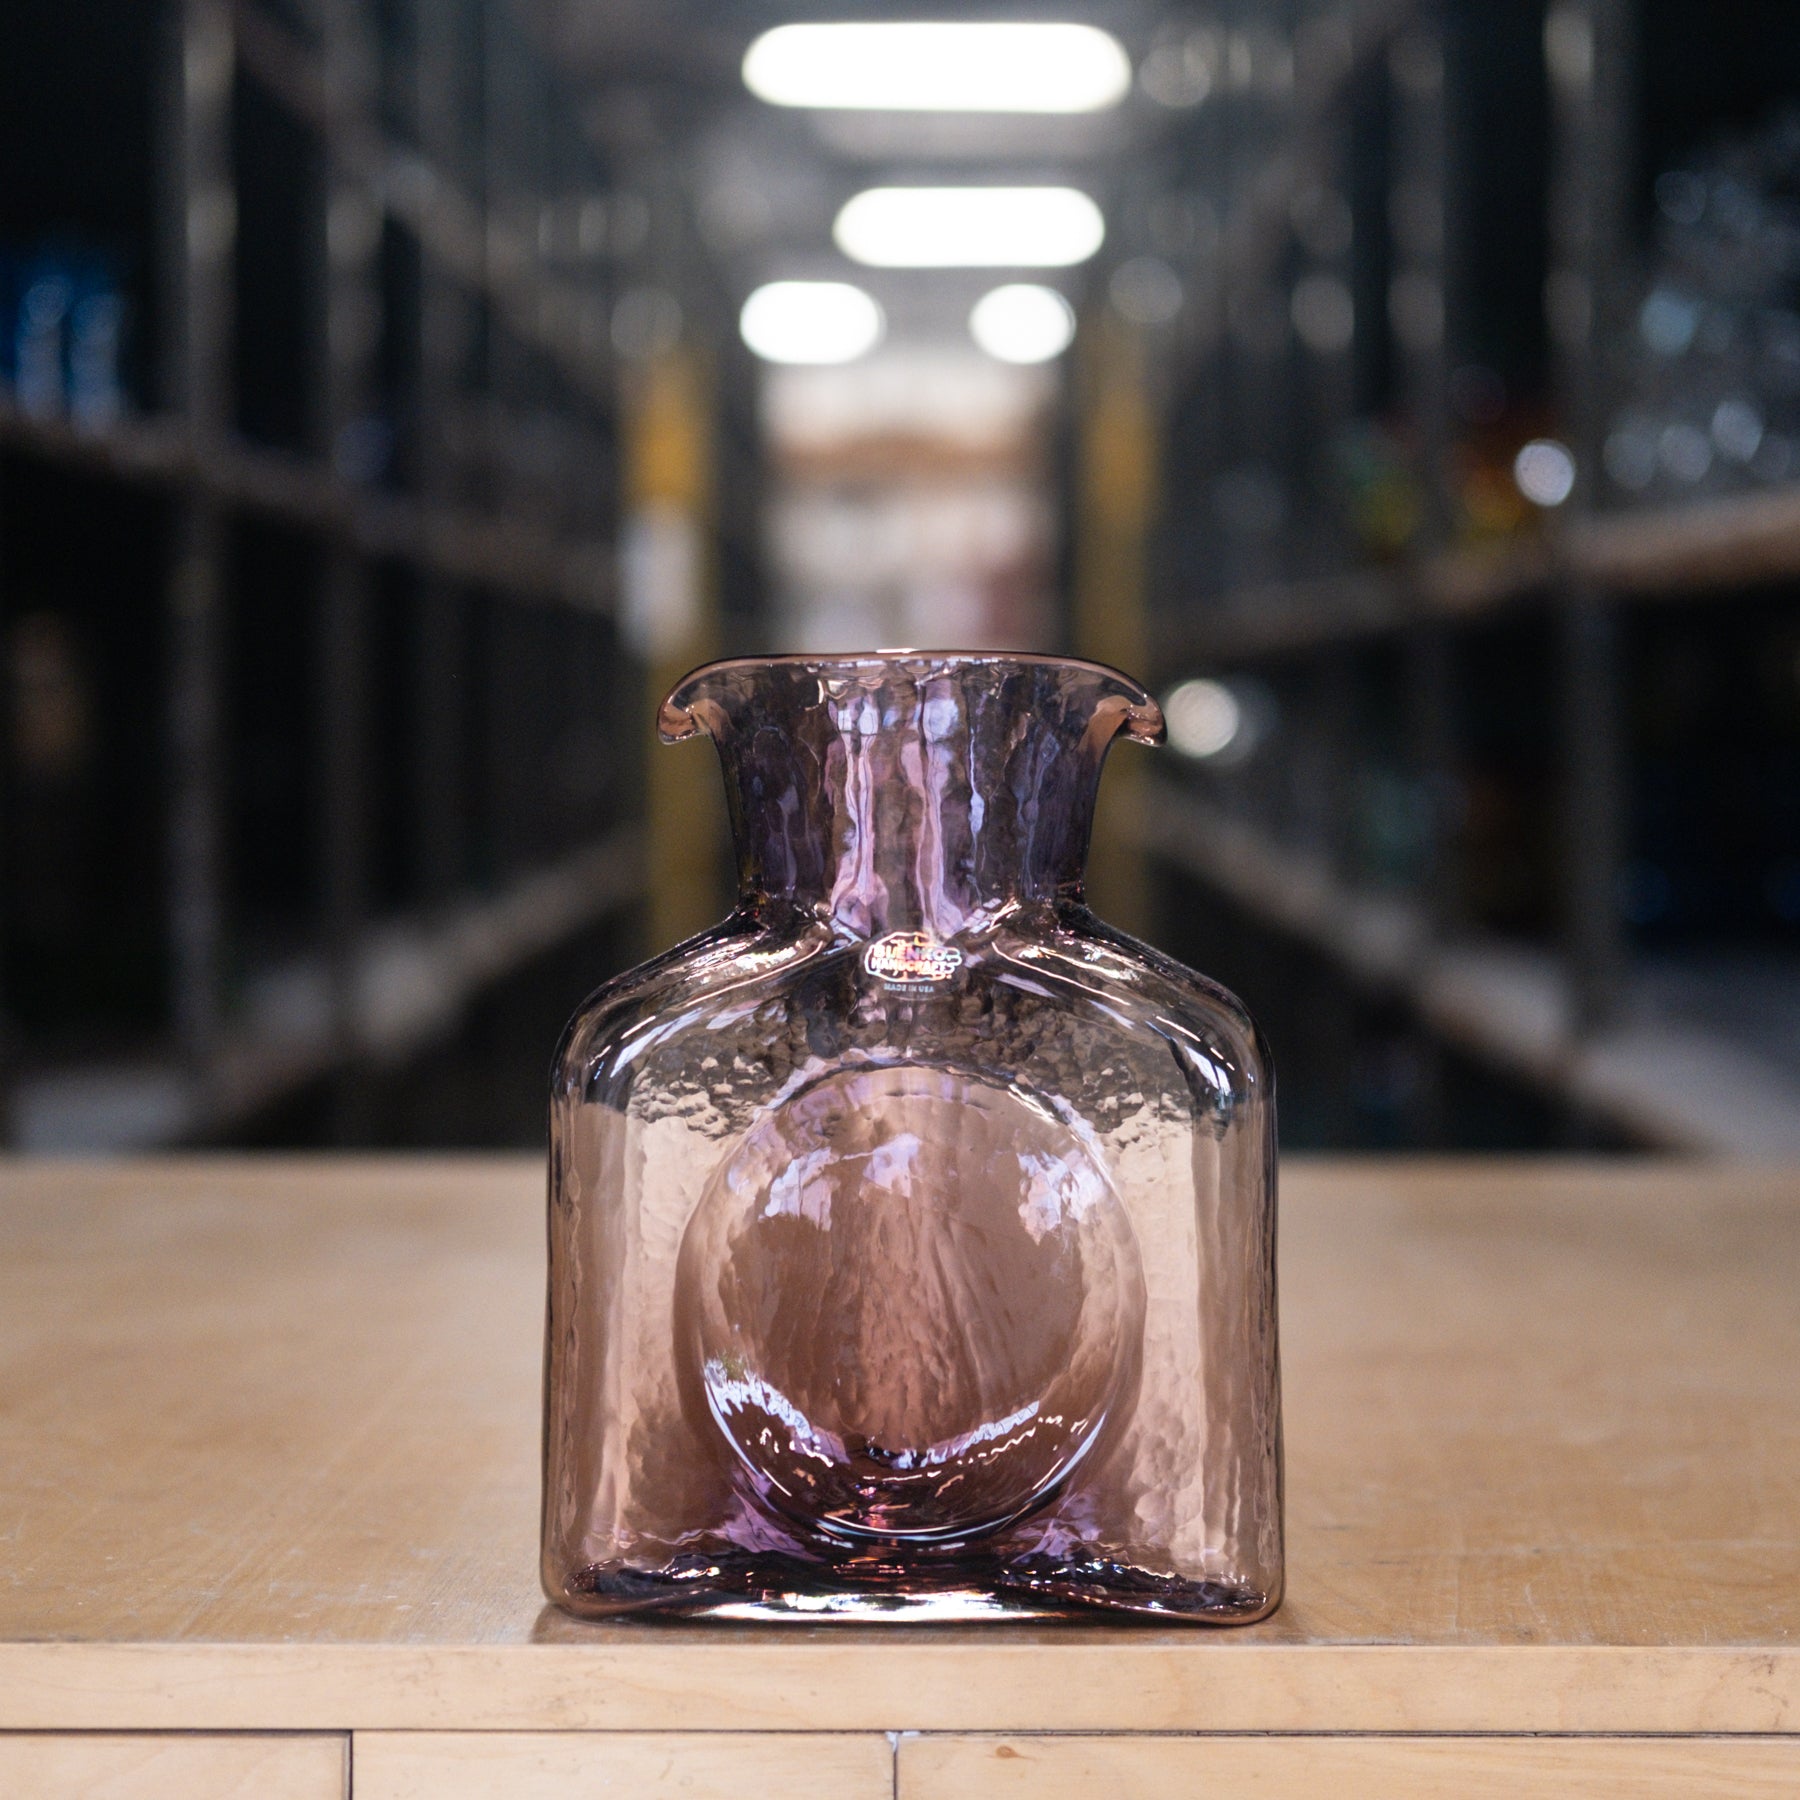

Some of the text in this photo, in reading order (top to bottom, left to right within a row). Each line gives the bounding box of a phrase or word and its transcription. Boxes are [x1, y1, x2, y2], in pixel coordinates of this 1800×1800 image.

[883, 983, 934, 993] MADE IN USA
